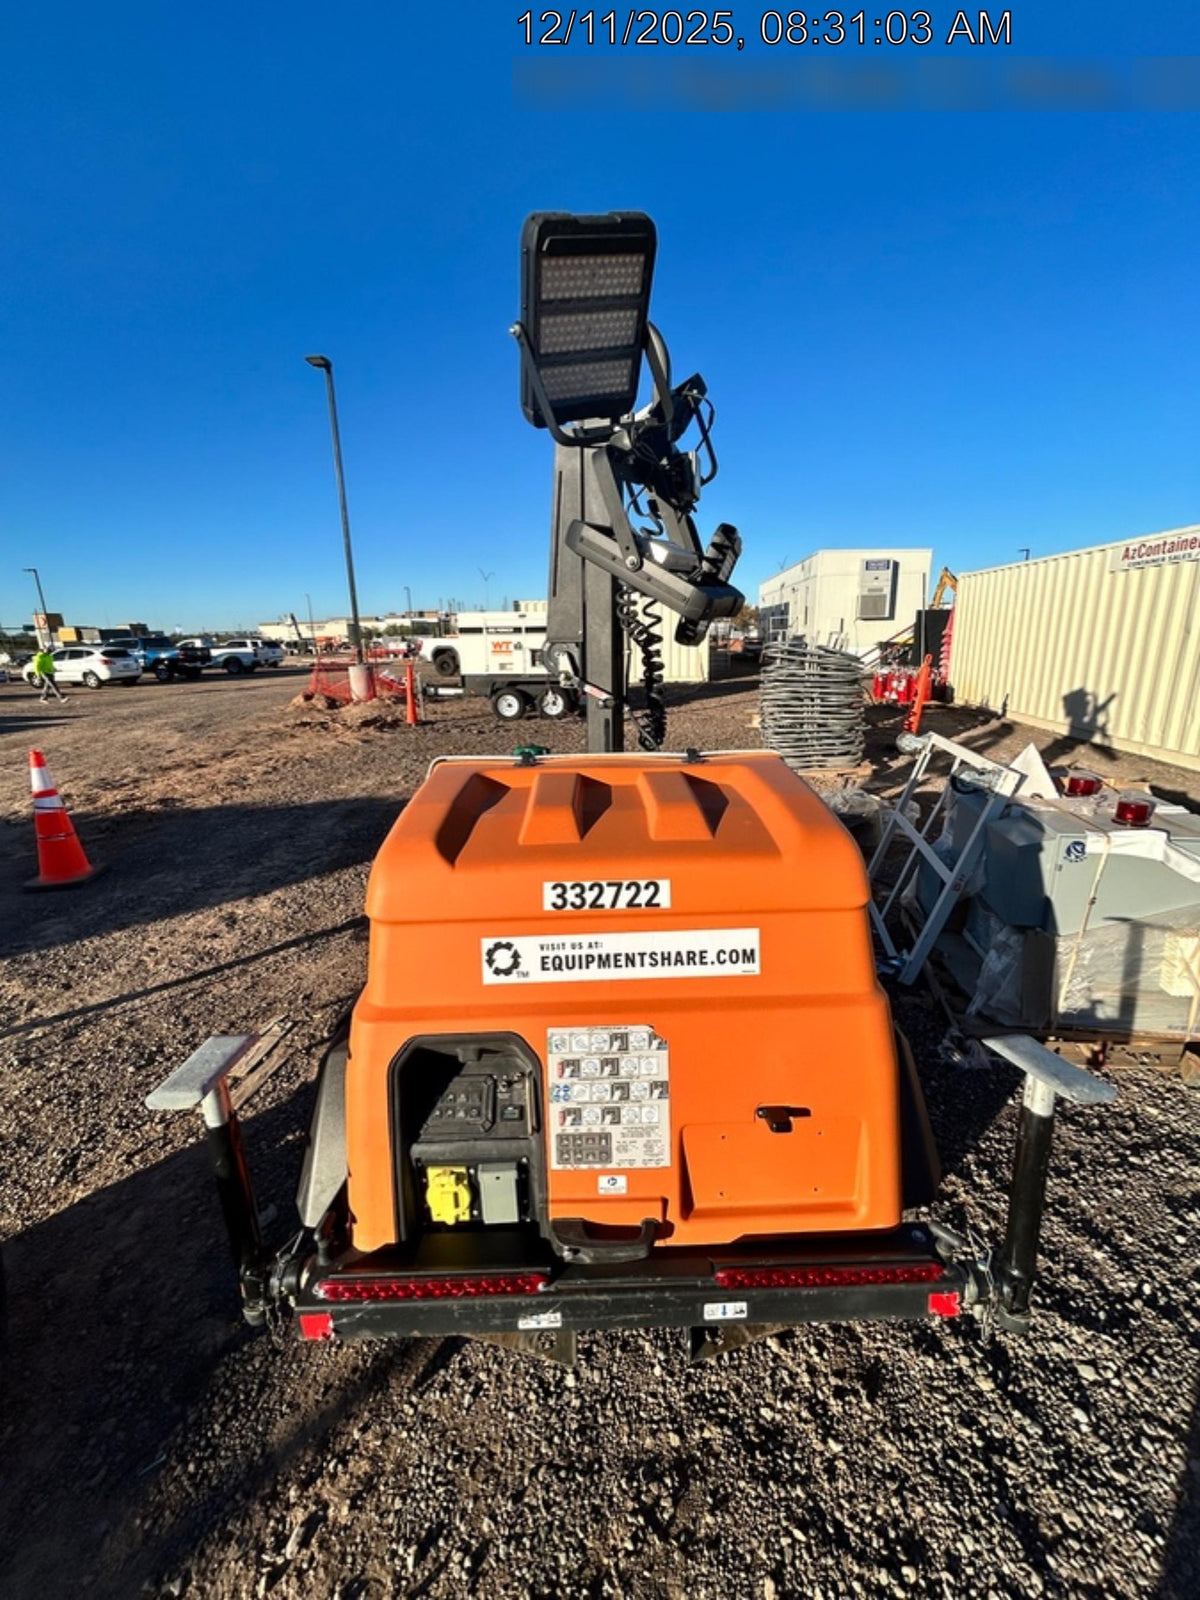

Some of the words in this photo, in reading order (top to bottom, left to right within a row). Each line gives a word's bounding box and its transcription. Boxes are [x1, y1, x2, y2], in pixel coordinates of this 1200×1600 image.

[551, 881, 661, 910] 332722
[539, 942, 567, 952] VISIT
[570, 941, 584, 951] US
[540, 948, 757, 972] EQUIPMENTSHARE.COM
